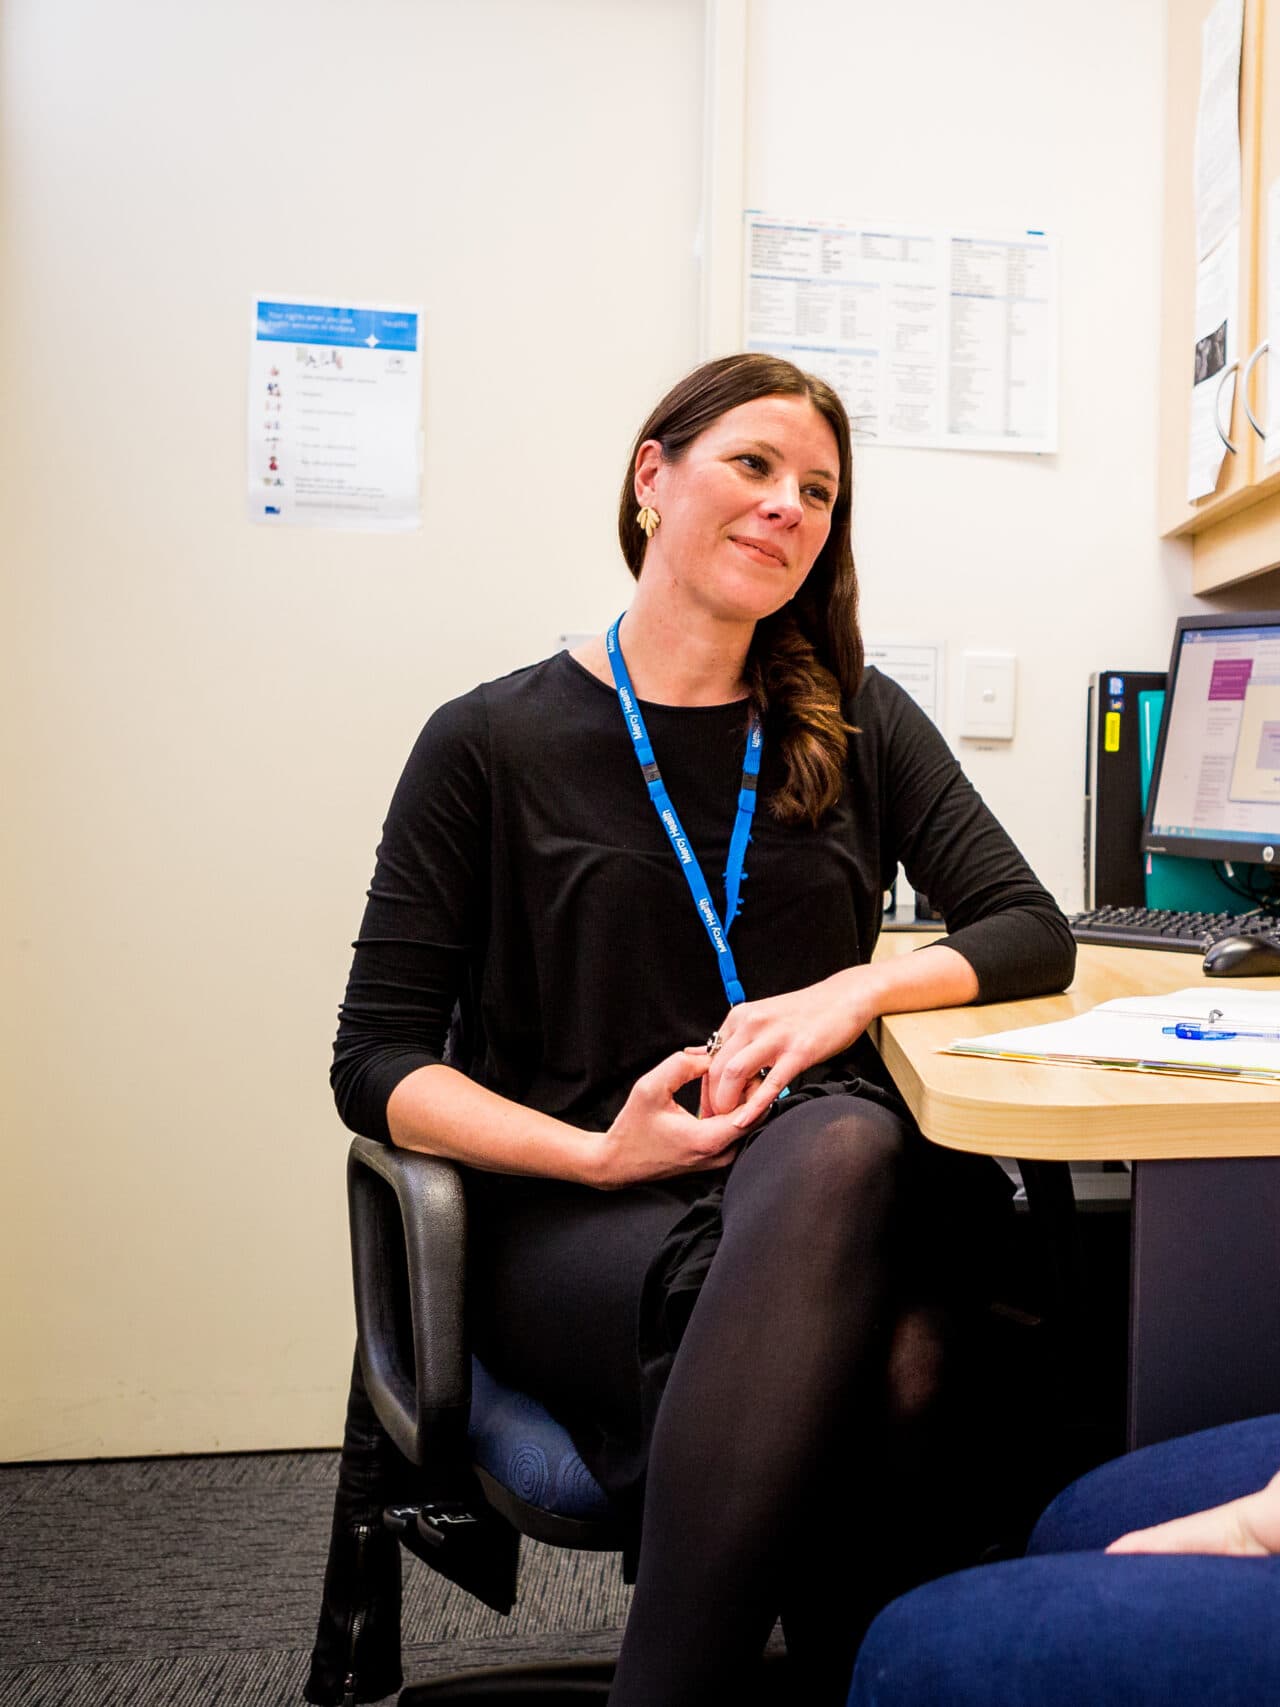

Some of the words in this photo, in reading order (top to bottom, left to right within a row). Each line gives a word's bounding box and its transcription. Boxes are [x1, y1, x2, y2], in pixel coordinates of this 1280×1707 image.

[619, 686, 634, 714] Health
[628, 714, 643, 740] Mercy
[661, 809, 681, 838] Health
[674, 838, 693, 864] Mercy
[698, 898, 717, 927] Health
[711, 926, 727, 953] Mercy
